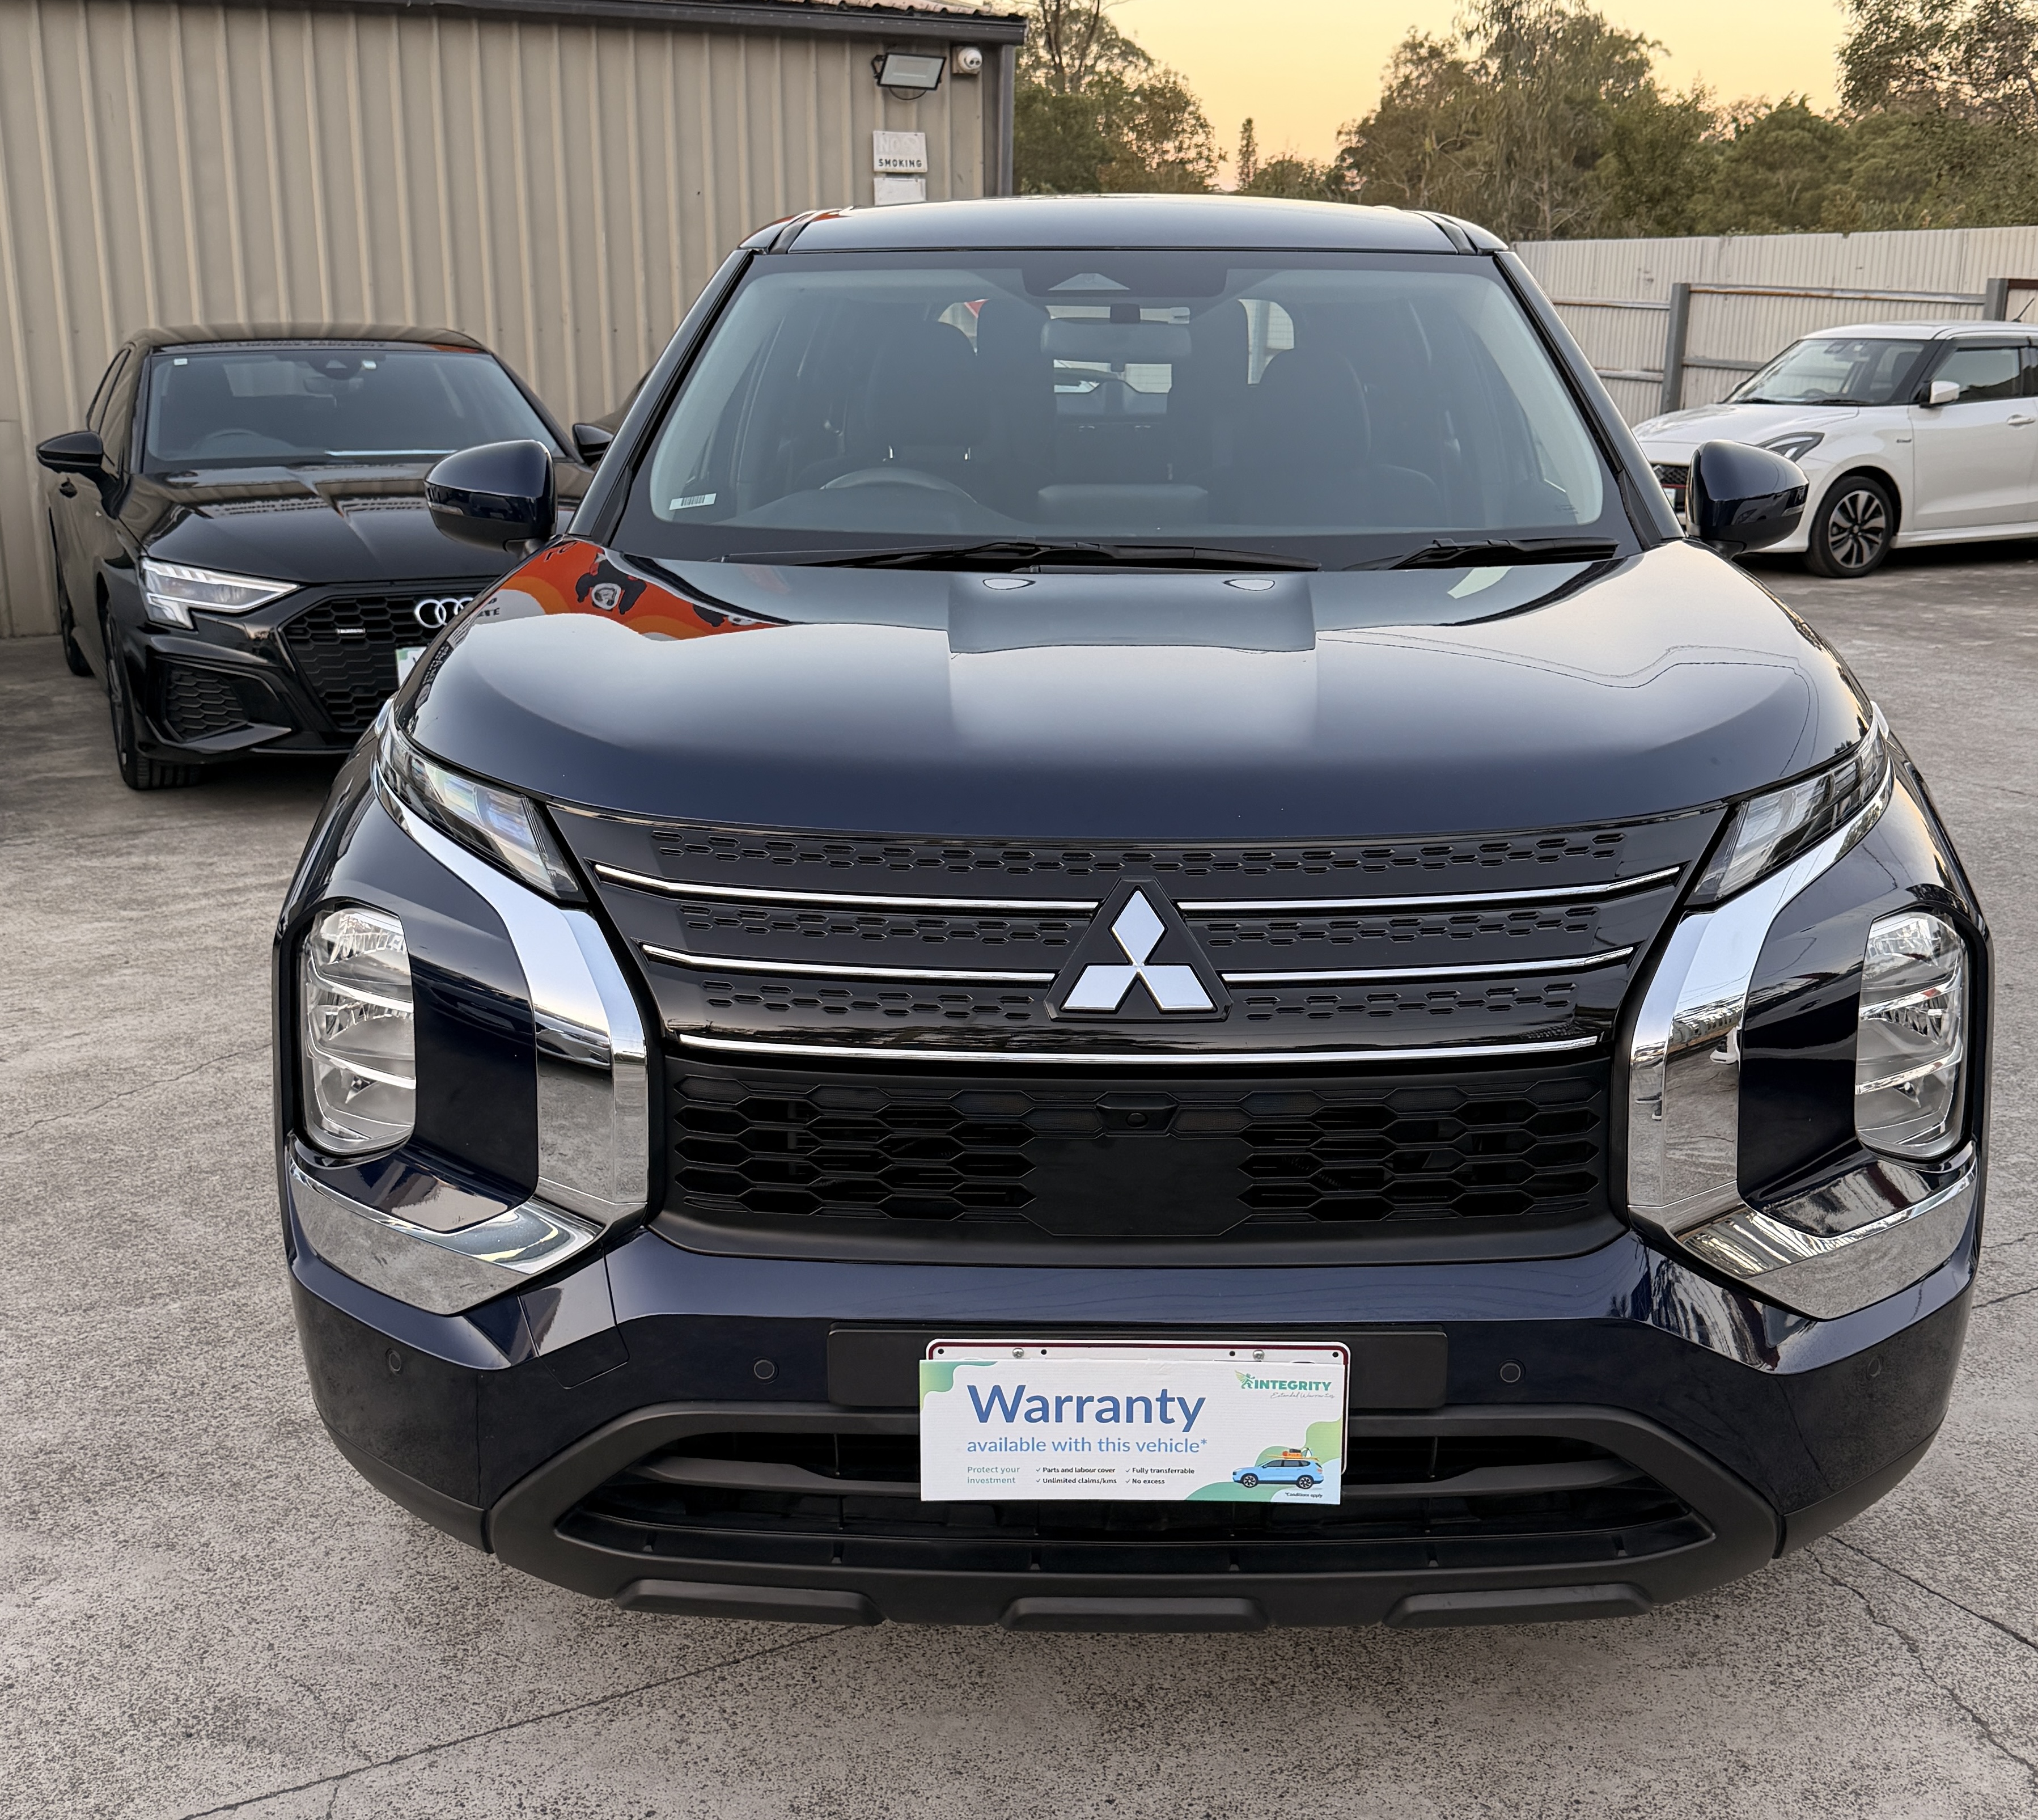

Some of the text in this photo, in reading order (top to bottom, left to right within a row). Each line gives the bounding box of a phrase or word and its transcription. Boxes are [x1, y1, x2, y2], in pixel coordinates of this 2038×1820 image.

[879, 159, 922, 167] SMOKING
[1255, 1379, 1332, 1391] INTEGRITY
[967, 1385, 1206, 1433] Warranty
[967, 1437, 1046, 1453] available
[1052, 1437, 1092, 1452] with
[1098, 1437, 1130, 1453] this
